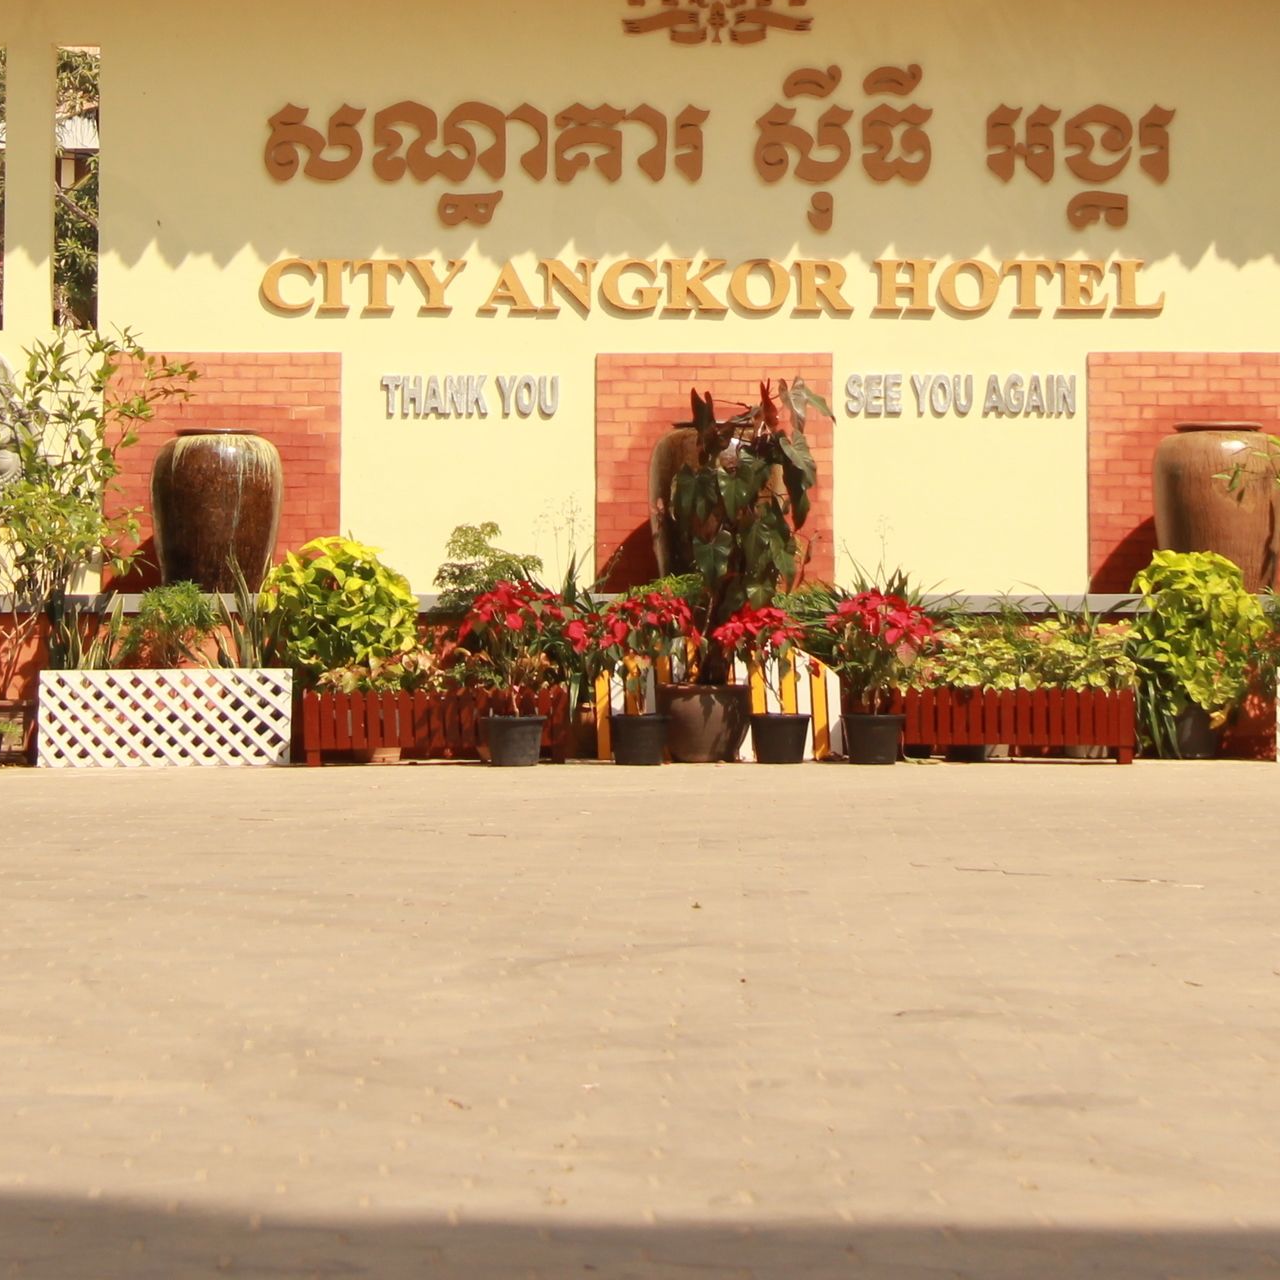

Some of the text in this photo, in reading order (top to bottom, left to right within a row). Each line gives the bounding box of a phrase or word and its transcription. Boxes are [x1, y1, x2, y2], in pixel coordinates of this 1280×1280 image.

[986, 103, 1176, 228] អង្គរ
[259, 257, 1165, 320] CITY ANGKOR HOTEL
[380, 374, 560, 420] THANK YOU
[844, 373, 1078, 420] SEE YOU AGAIN
